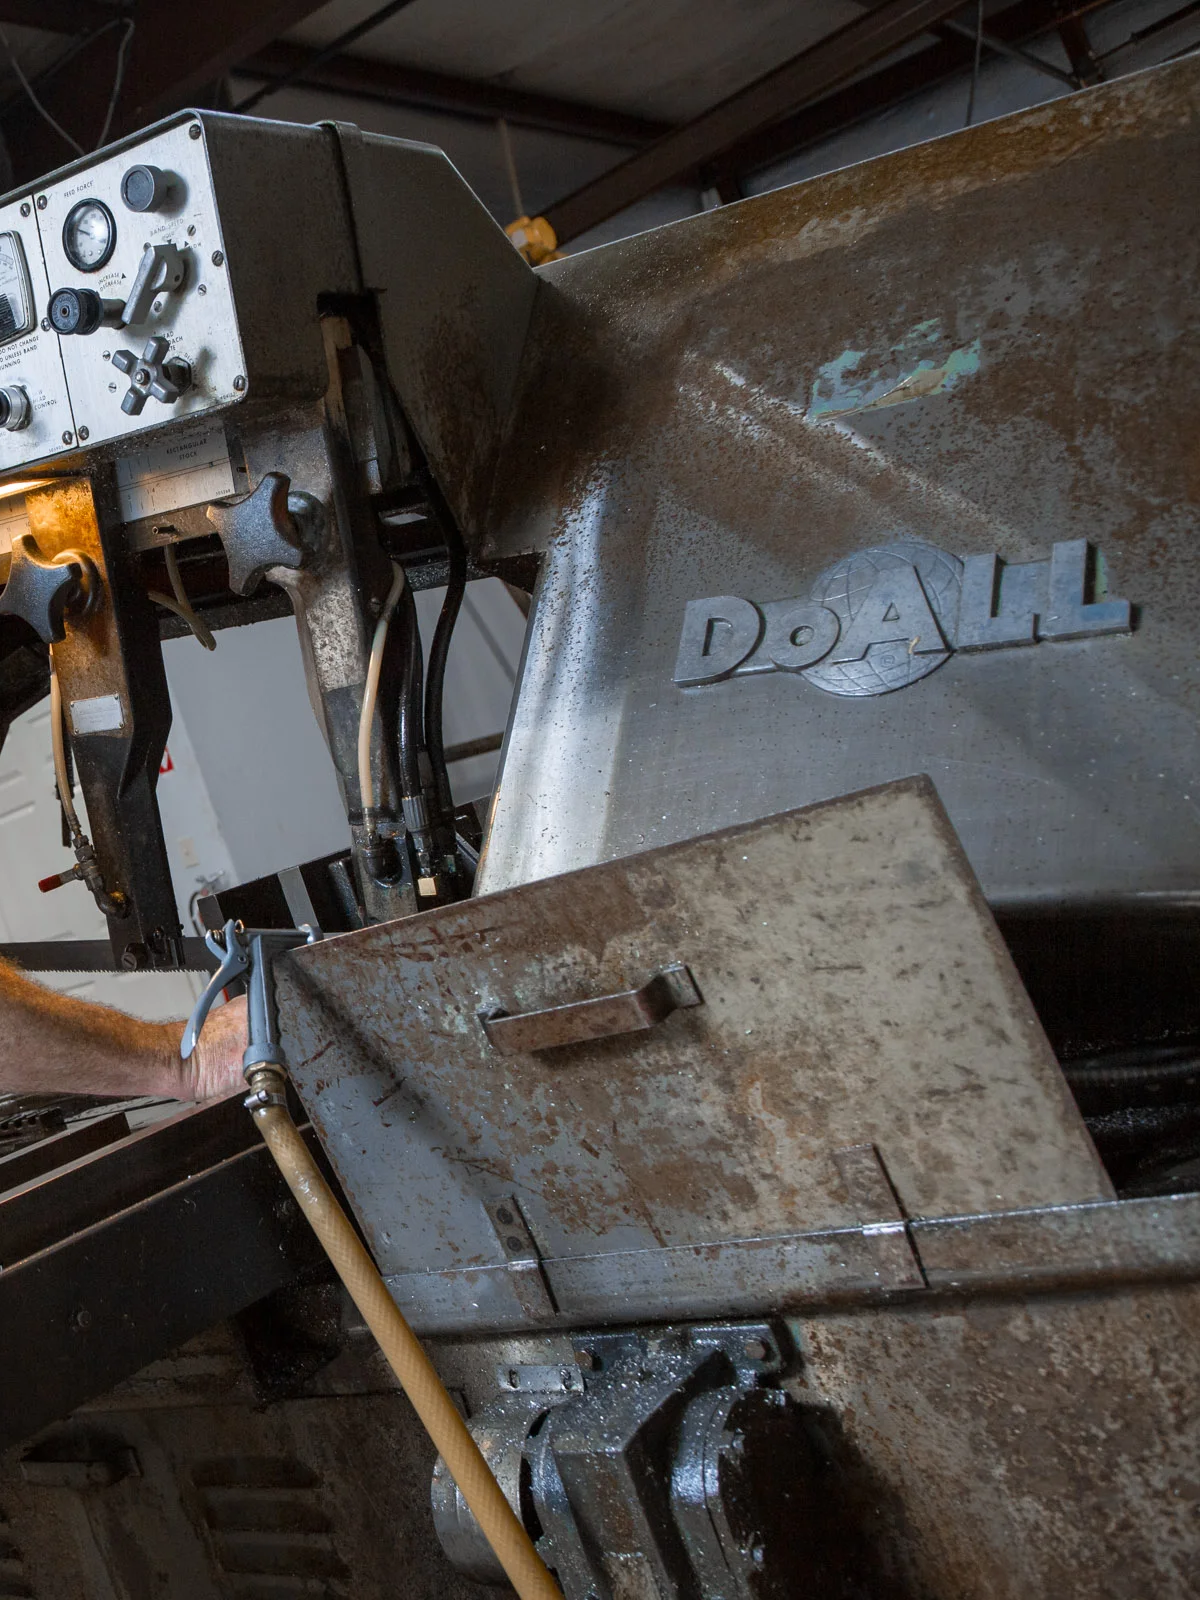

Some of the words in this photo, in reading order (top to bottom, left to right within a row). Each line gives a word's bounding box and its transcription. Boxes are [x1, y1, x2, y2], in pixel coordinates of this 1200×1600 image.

[63, 188, 75, 198] FEED
[77, 181, 93, 193] FORCE
[150, 225, 166, 237] BAND
[98, 271, 120, 285] INCREASE
[100, 279, 122, 291] DECREASE
[7, 343, 18, 353] NOT
[19, 335, 39, 347] CHANGE
[5, 351, 22, 361] UNLESS
[23, 344, 38, 354] BAND
[34, 399, 57, 411] CONTROL
[166, 438, 207, 455] RECTANGULAR
[179, 451, 198, 461] STOCK
